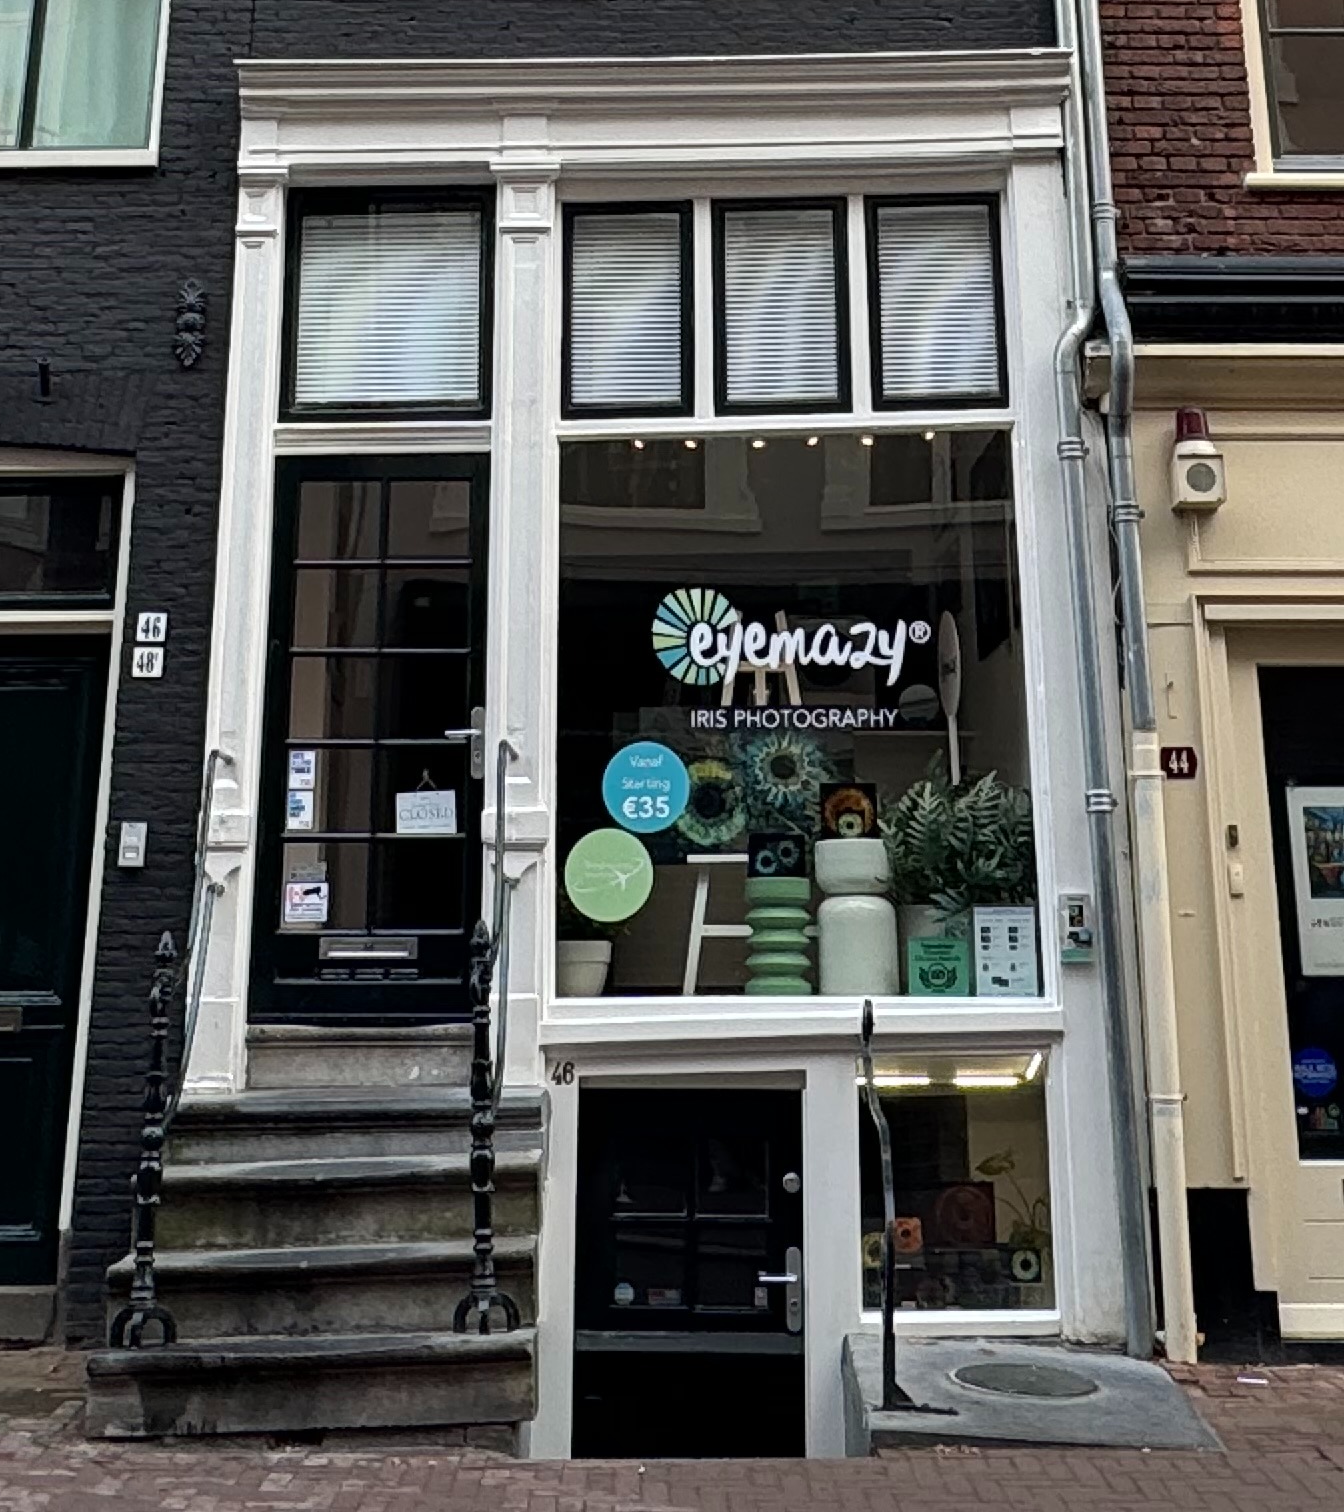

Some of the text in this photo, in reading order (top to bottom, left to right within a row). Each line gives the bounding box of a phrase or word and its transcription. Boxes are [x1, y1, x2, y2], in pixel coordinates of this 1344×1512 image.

[140, 616, 162, 639] 46
[690, 708, 899, 728] IRIS PHOTOGRAPHY
[1168, 749, 1189, 774] 44
[622, 795, 670, 819] €35
[551, 1060, 575, 1085] 46
